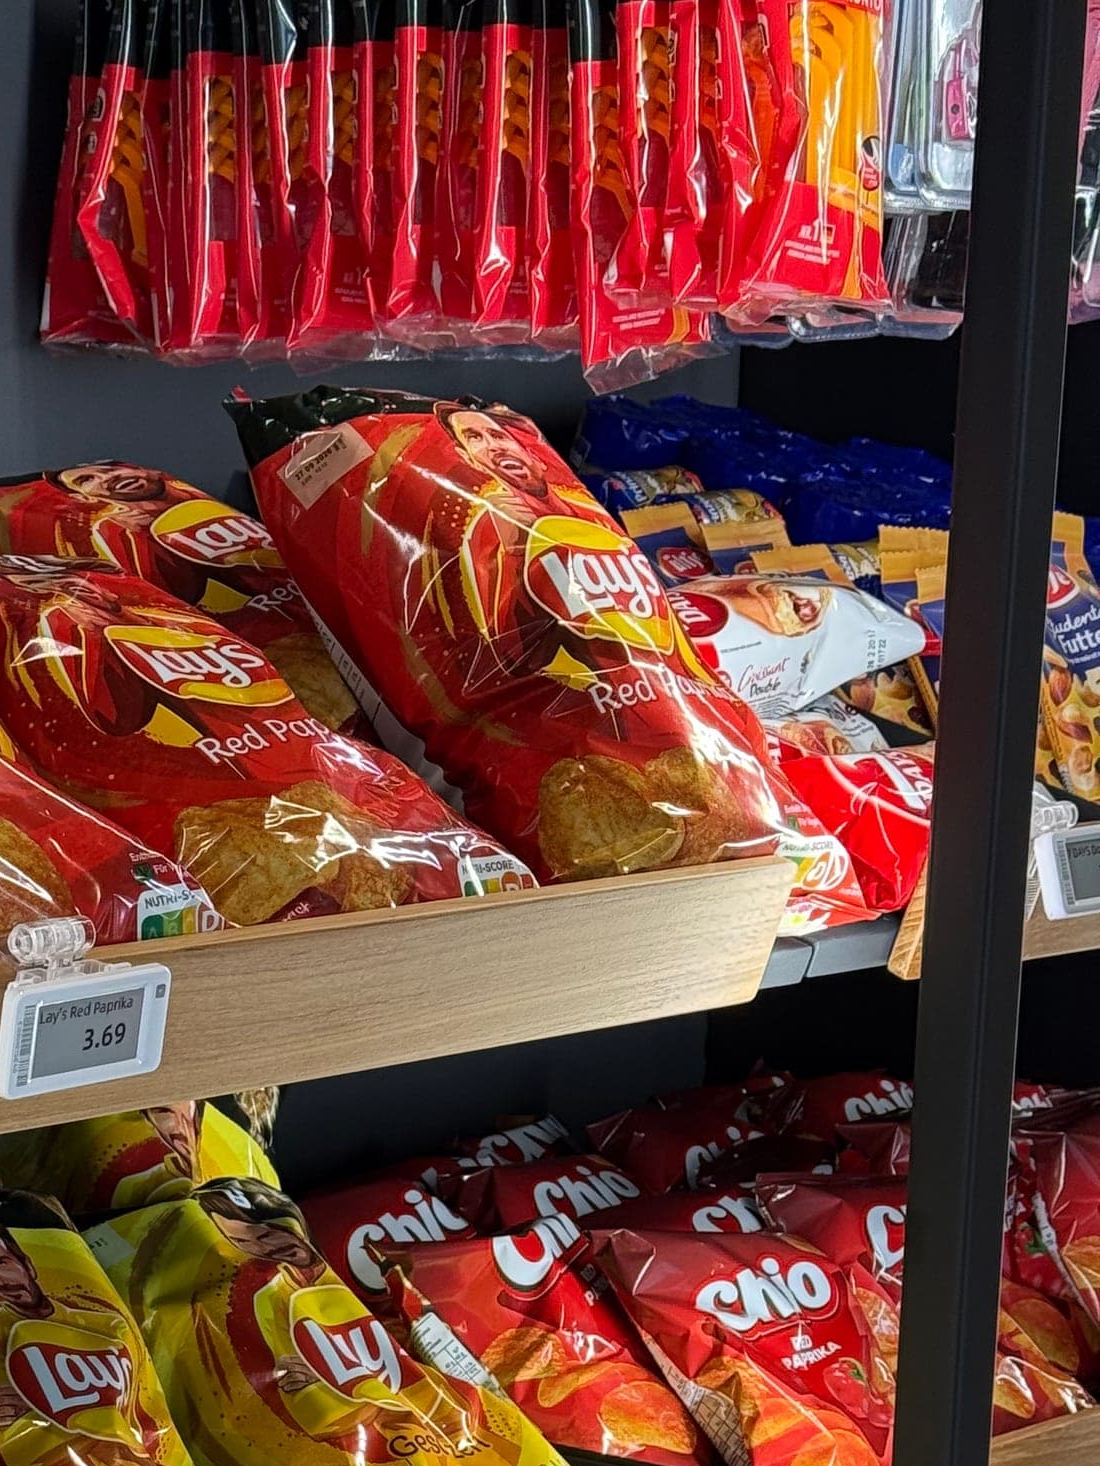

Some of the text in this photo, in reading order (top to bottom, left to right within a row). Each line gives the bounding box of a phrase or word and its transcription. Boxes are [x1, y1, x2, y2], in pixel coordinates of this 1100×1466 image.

[138, 639, 264, 686] Lay's
[588, 674, 656, 715] Red
[196, 724, 268, 766] Red
[39, 996, 134, 1026] Lay's Red Paprika
[82, 1022, 127, 1051] 3.69
[533, 1164, 641, 1217] Chio
[695, 1257, 832, 1333] Chio
